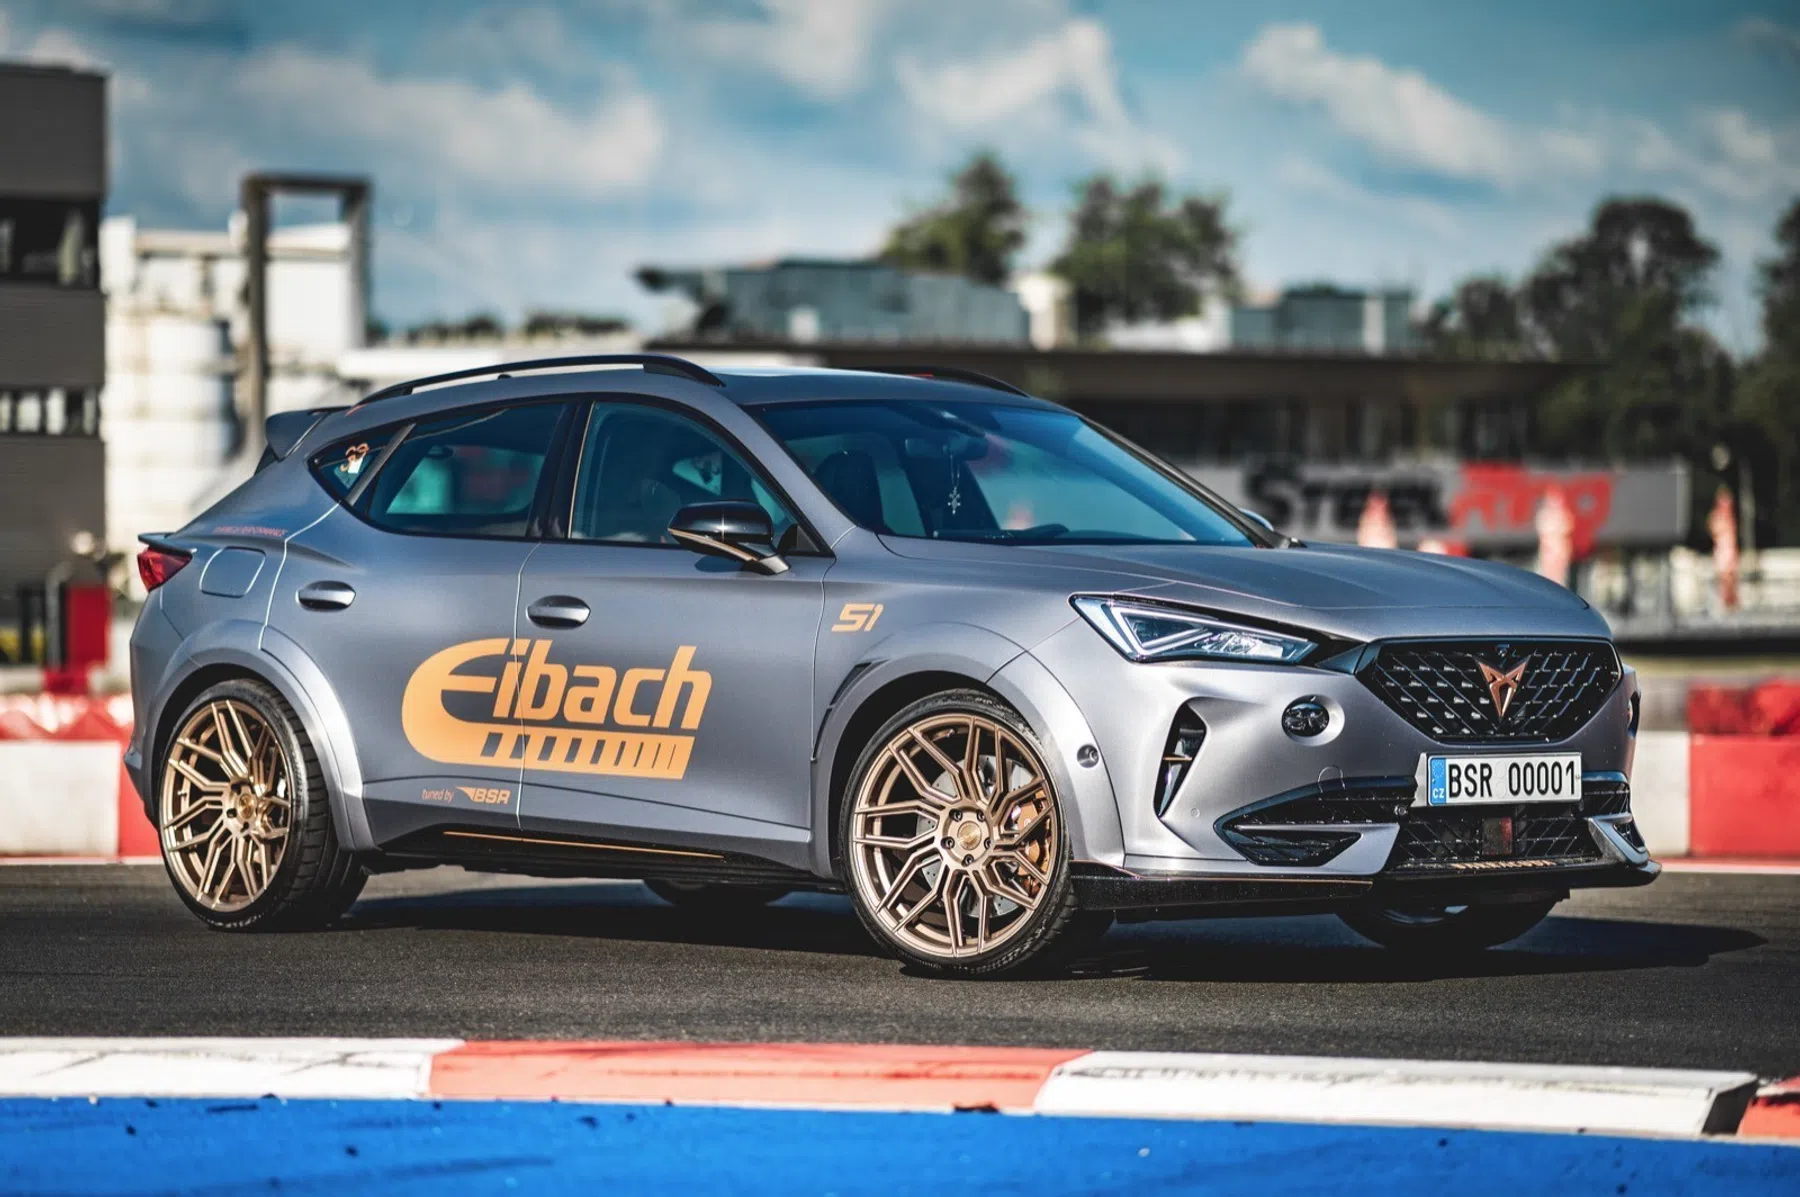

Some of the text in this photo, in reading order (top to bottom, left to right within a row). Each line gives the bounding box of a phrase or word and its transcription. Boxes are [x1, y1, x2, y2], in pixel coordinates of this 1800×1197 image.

[402, 638, 712, 780] Eibach
[1449, 760, 1575, 798] BSR 00001
[422, 787, 511, 804] tuned by BSR
[1432, 787, 1445, 799] CZ
